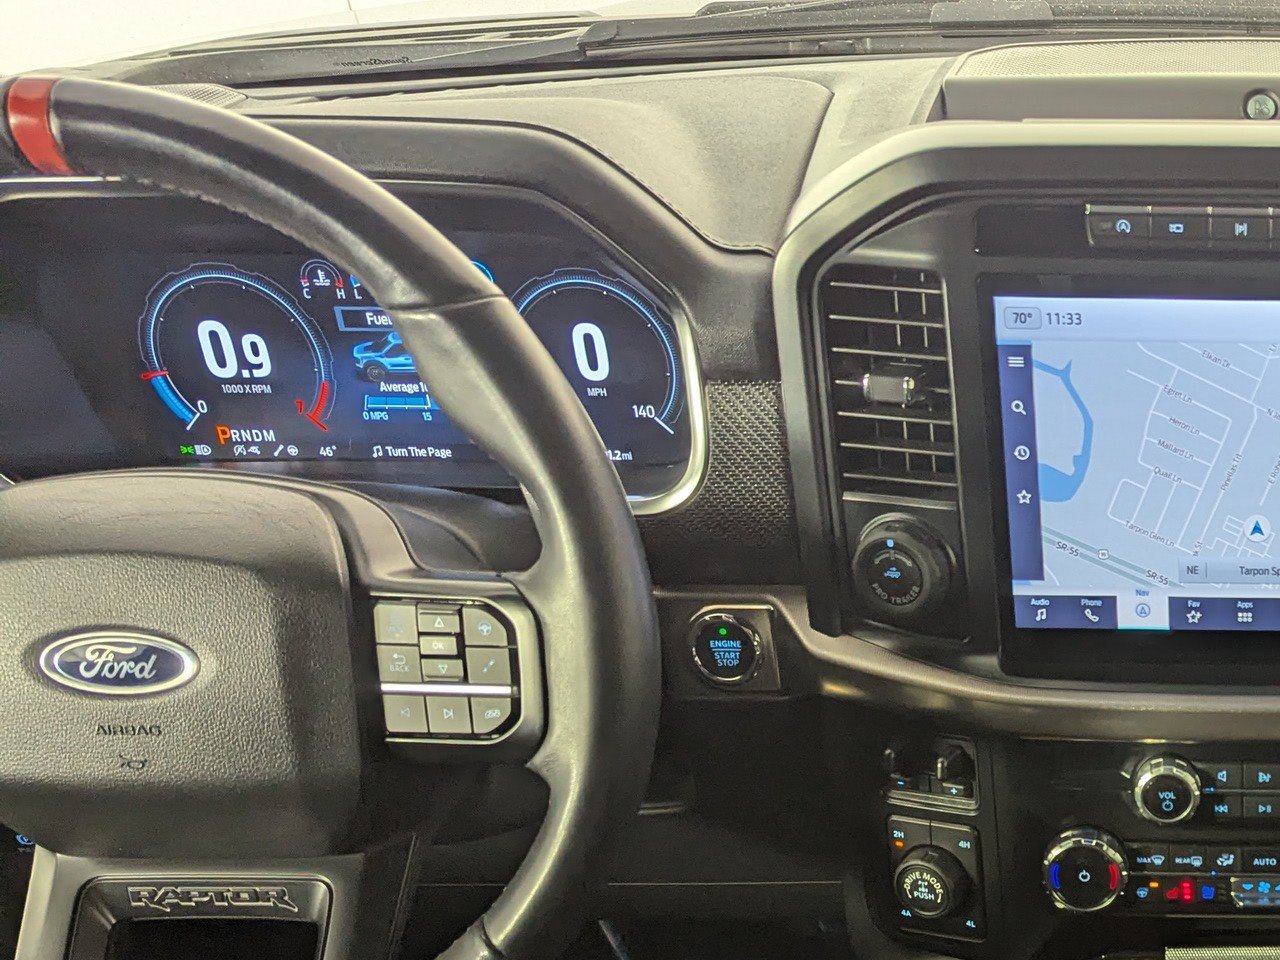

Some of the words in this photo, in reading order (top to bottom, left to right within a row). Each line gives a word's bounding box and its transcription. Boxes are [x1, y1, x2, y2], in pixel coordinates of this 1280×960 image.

[303, 288, 312, 299] C
[336, 288, 346, 299] H
[366, 312, 393, 326] Fuel
[1012, 312, 1033, 324] 70°
[1046, 312, 1082, 325] 11:33
[197, 319, 272, 379] 0.9
[572, 322, 610, 382] 0
[221, 384, 244, 394] 1000
[244, 384, 252, 394] X
[251, 384, 272, 394] RPM
[380, 381, 420, 394] Average
[587, 387, 607, 397] MPH
[362, 411, 369, 420] 0
[370, 411, 389, 420] MPG
[632, 404, 655, 418] 140
[422, 412, 432, 421] 15
[319, 445, 336, 458] 46°
[386, 446, 408, 458] Turn
[408, 446, 428, 458] The
[428, 447, 452, 459] Page
[1125, 520, 1149, 536] Tarpon
[1056, 541, 1079, 557] SR-55
[1186, 566, 1199, 574] NE
[1239, 565, 1269, 576] Tarpon
[1146, 569, 1169, 586] SR-55
[1135, 588, 1150, 597] Nav
[1030, 598, 1050, 606] Audio
[1081, 599, 1102, 607] Phone
[1187, 600, 1200, 608] Fav
[1237, 601, 1253, 609] Apps
[710, 640, 741, 648] ENGINE
[714, 652, 740, 660] START
[79, 644, 157, 680] Ford
[718, 659, 739, 667] STOP
[95, 724, 162, 736] AIRBAG
[1158, 791, 1176, 800] VOL
[893, 830, 904, 838] 2H
[958, 840, 971, 849] 4H
[1253, 858, 1277, 866] AUTO
[903, 871, 921, 890] DRIVE
[922, 872, 944, 894] MODE
[127, 886, 299, 912] RAPTOR
[913, 891, 935, 900] PUSH
[901, 909, 912, 917] 4A
[966, 920, 976, 928] 4L
